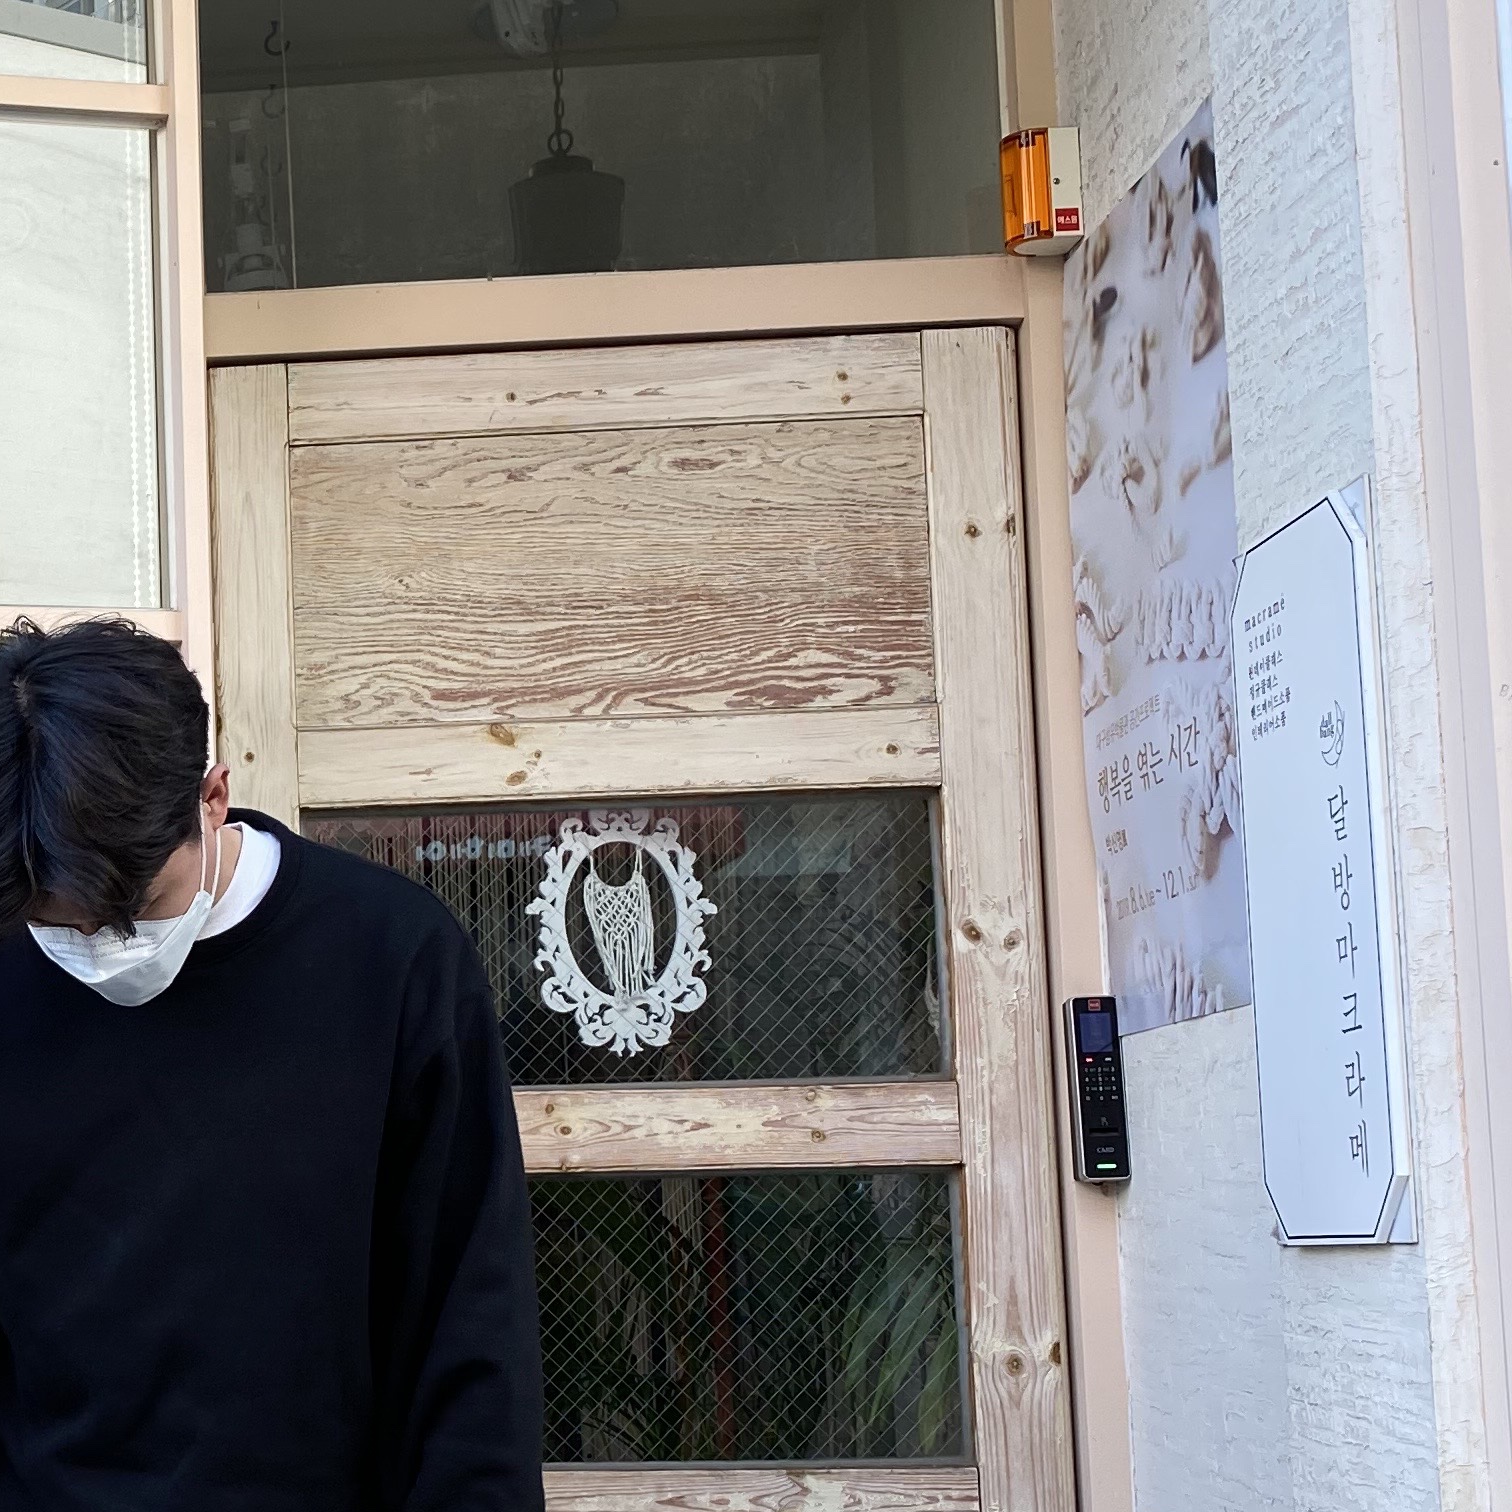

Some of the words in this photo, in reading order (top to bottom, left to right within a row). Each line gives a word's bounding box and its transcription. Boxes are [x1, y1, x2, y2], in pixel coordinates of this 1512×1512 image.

[1248, 623, 1282, 653] studio
[1098, 754, 1133, 813] 행복을
[1168, 716, 1200, 773] 시간
